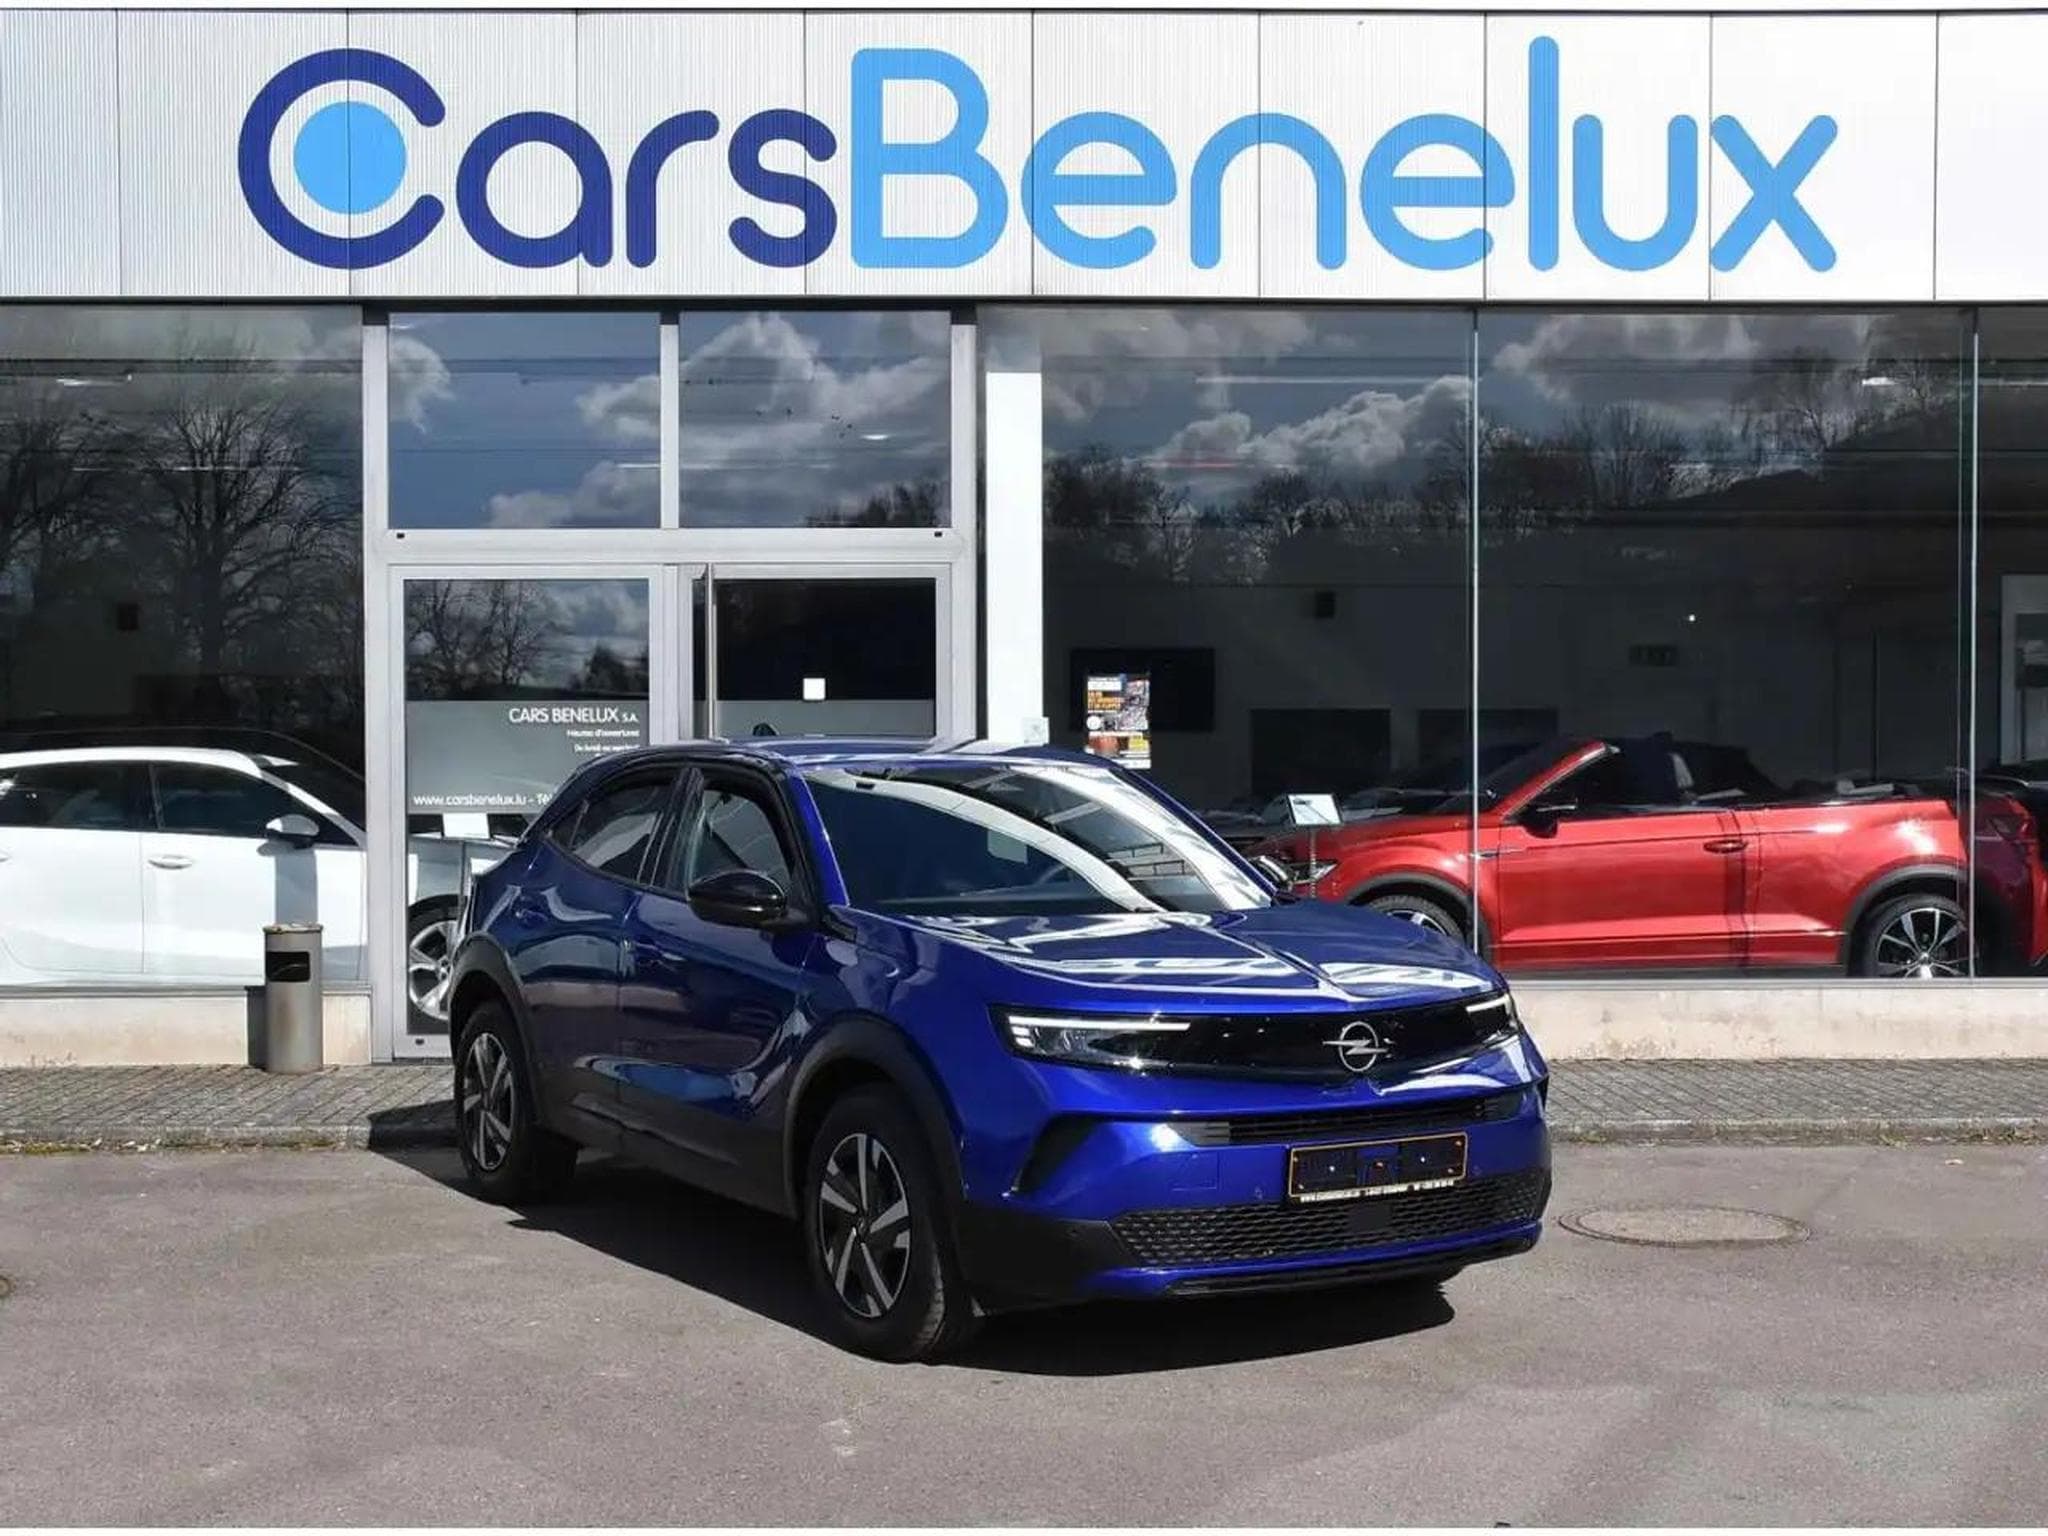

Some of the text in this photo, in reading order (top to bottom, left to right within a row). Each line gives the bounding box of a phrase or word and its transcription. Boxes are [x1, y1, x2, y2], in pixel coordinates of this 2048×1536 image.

[509, 707, 549, 723] CARS
[552, 707, 619, 723] BENELUX
[413, 793, 527, 805] www.carsbenelux.lu
